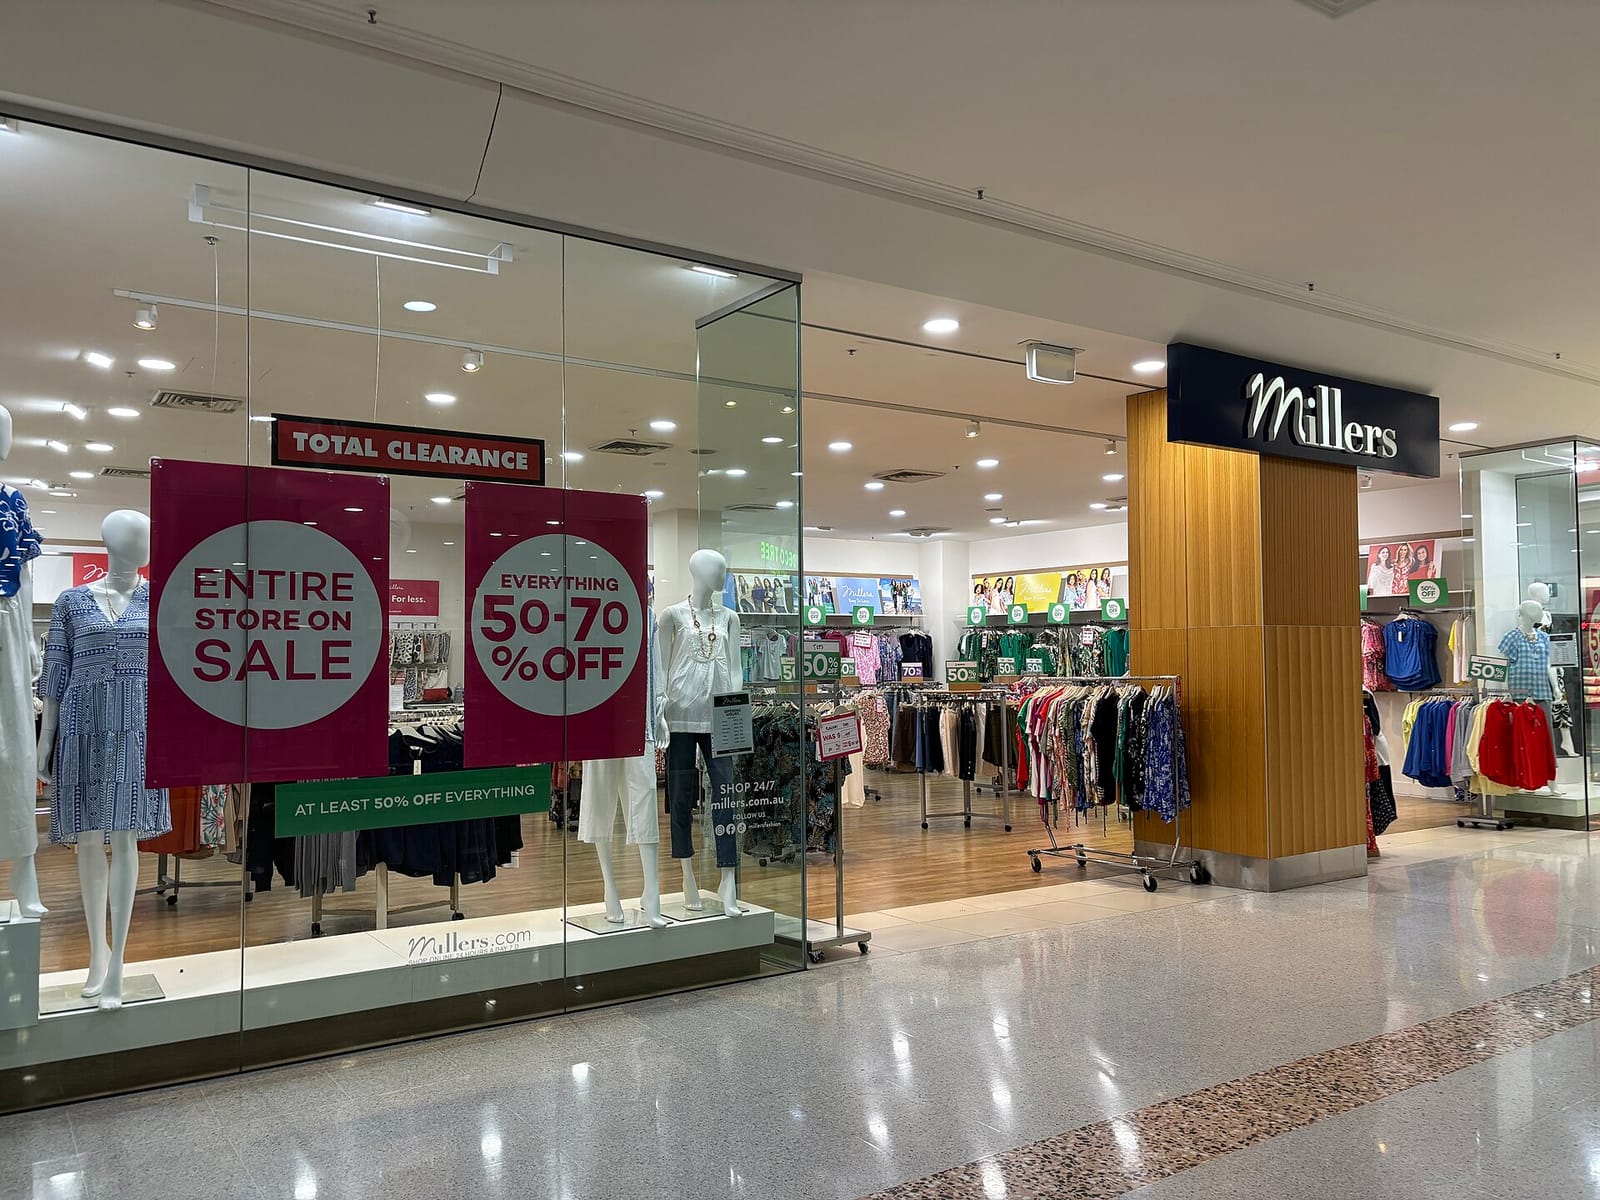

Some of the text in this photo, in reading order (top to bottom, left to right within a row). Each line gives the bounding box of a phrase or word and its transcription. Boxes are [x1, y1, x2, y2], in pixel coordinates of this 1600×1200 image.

[1248, 373, 1398, 458] Millers
[292, 432, 528, 470] TOTAL CLEARANCE
[194, 568, 354, 601] ENTIRE
[501, 574, 619, 591] EVERYTHING
[391, 594, 426, 603] For less.
[195, 608, 351, 630] STORE ON
[480, 595, 629, 642] 50-70
[193, 639, 352, 682] SALE
[294, 785, 535, 816] AT LEAST 50% OFF EVERYTHING
[720, 781, 775, 795] SHOP 24/7
[711, 796, 784, 810] millers.com.au
[732, 812, 757, 820] FOLLOW
[408, 930, 531, 958] Millers.com
